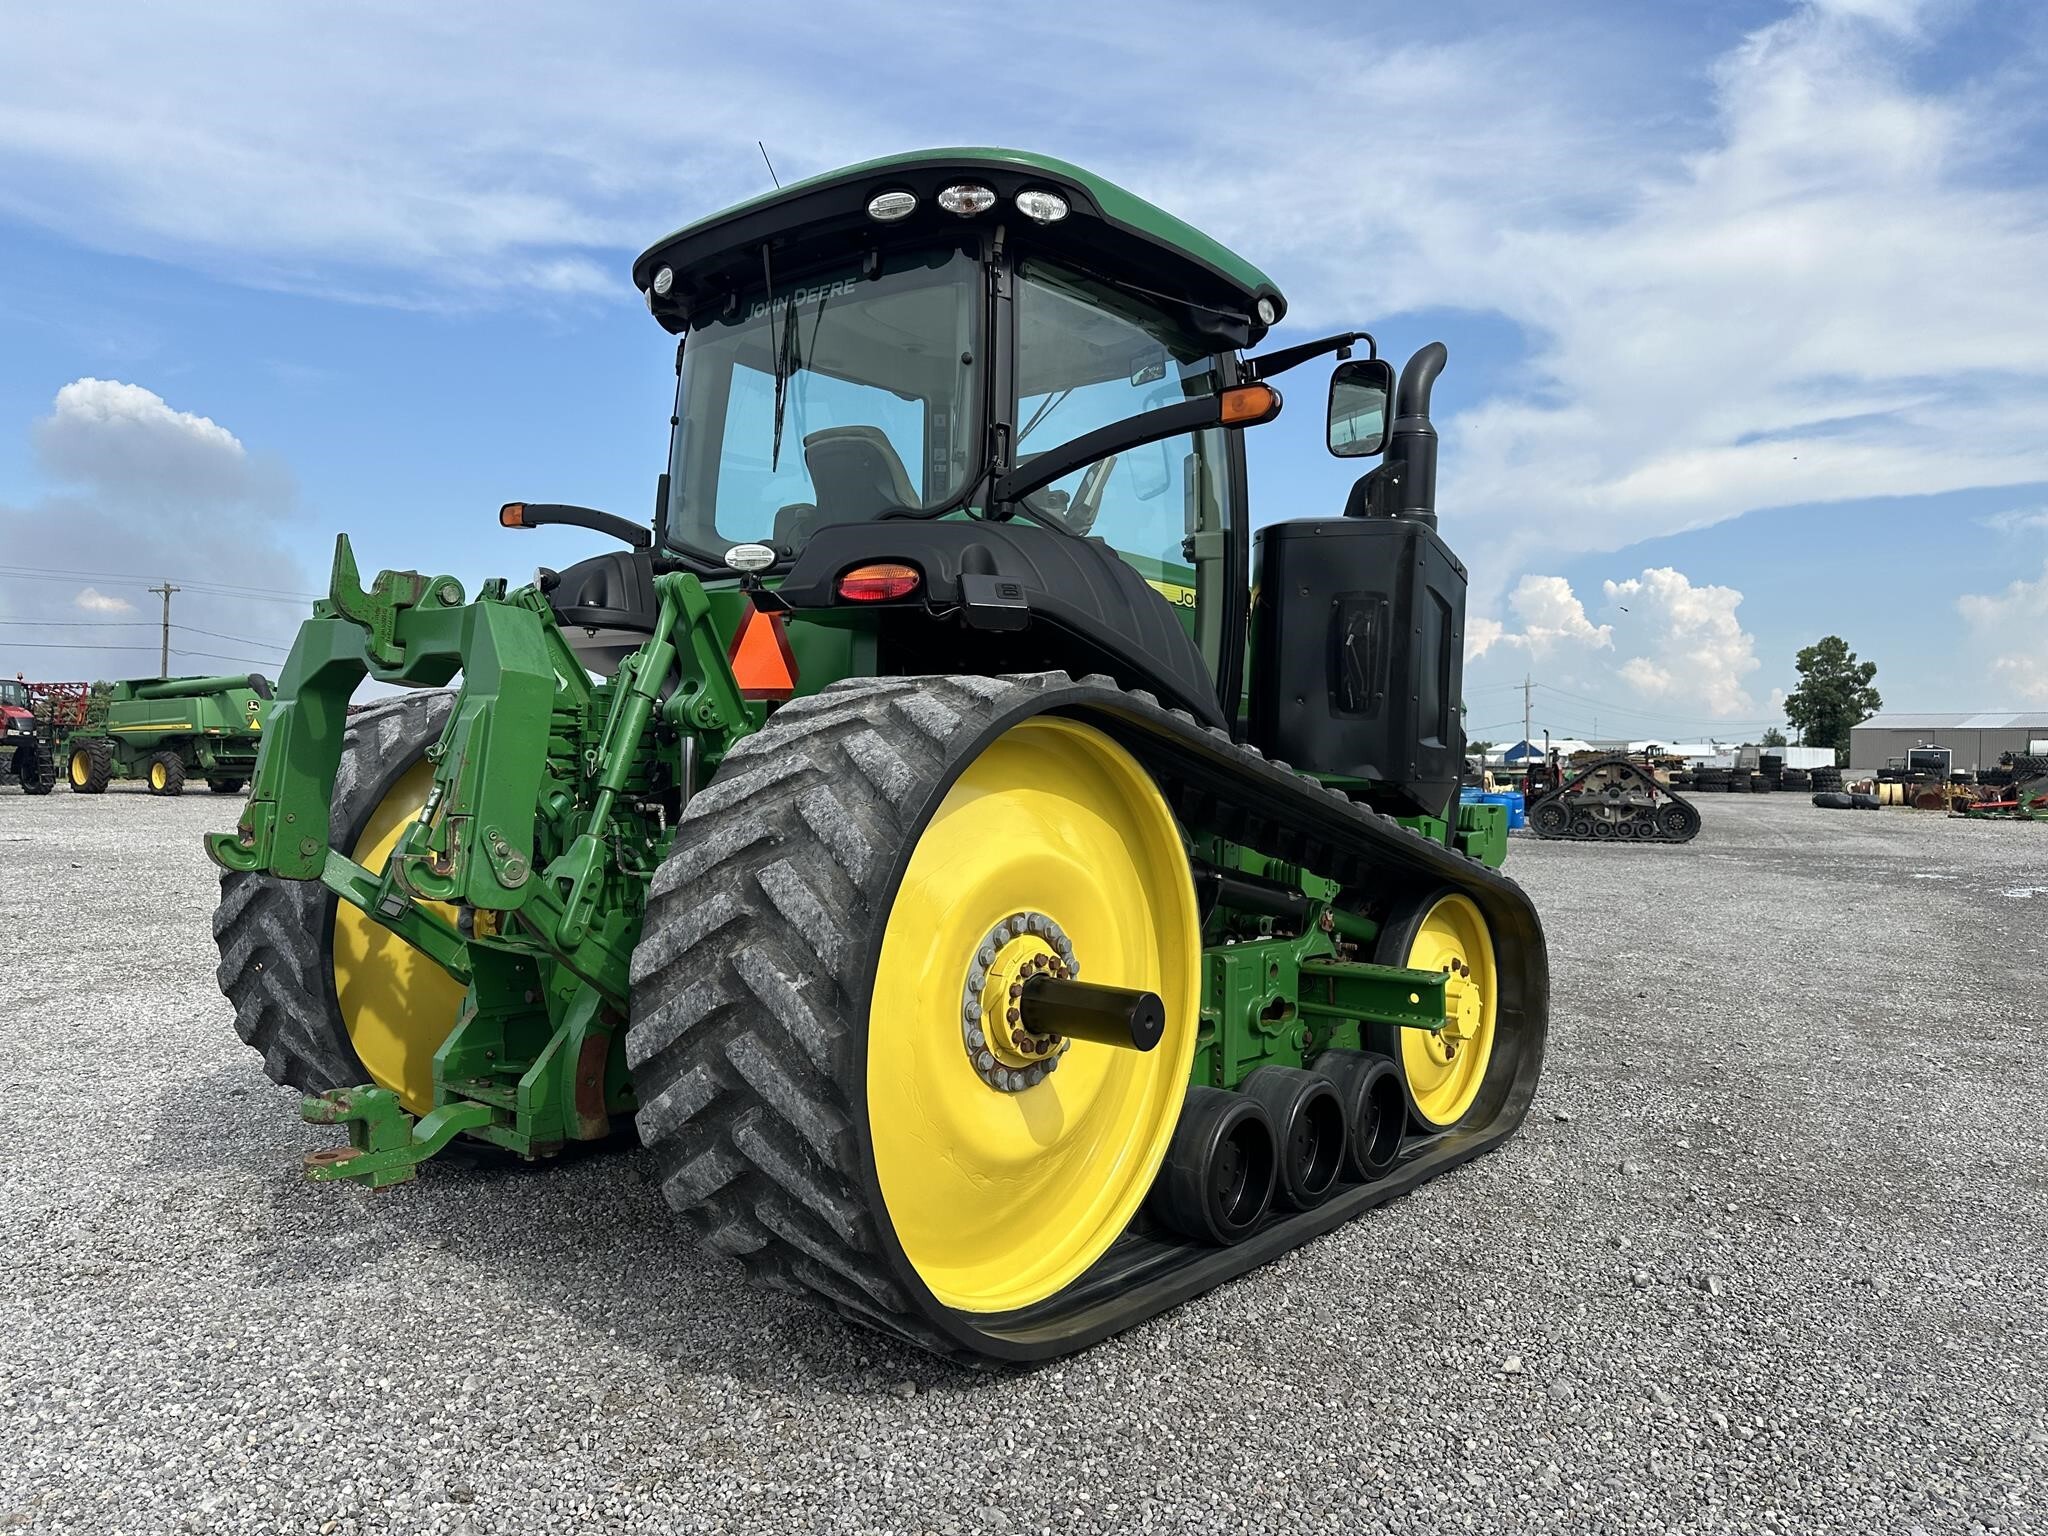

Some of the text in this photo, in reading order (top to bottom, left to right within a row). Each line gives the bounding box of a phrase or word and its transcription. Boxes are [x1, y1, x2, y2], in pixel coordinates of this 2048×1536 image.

[745, 278, 856, 321] JOHN DEERE
[1176, 589, 1196, 607] JO
